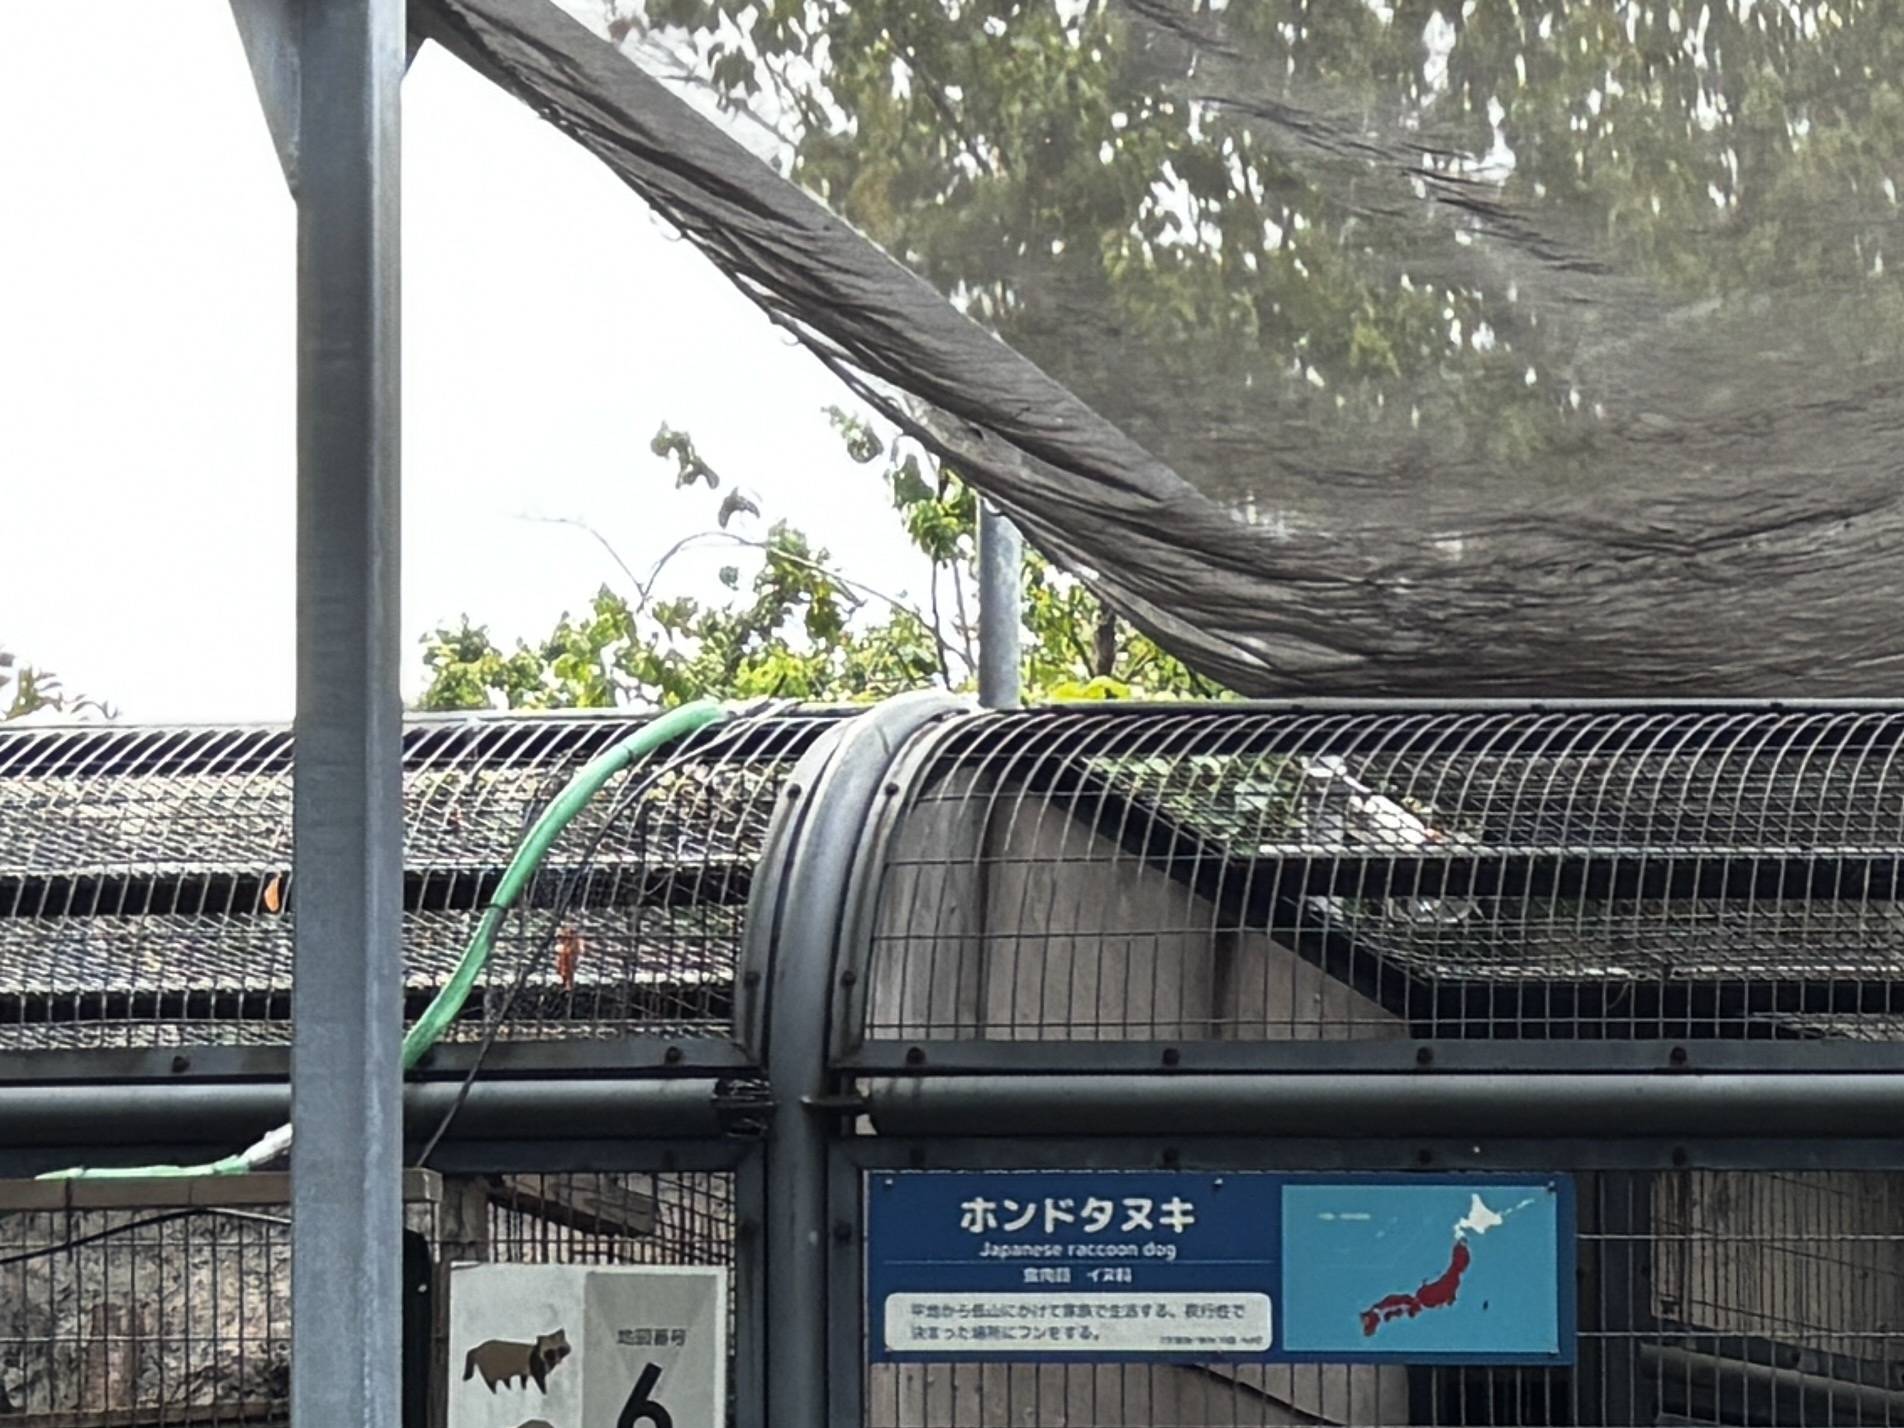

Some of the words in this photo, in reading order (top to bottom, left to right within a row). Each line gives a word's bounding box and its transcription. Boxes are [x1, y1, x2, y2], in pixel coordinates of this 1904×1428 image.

[960, 1196, 1195, 1234] ホンドタヌキ
[979, 1241, 1062, 1259] Japanese
[1068, 1243, 1138, 1257] raccoon
[1142, 1241, 1176, 1262] dog
[1087, 1267, 1133, 1284] イヌ科
[616, 1328, 687, 1347] 地図番号
